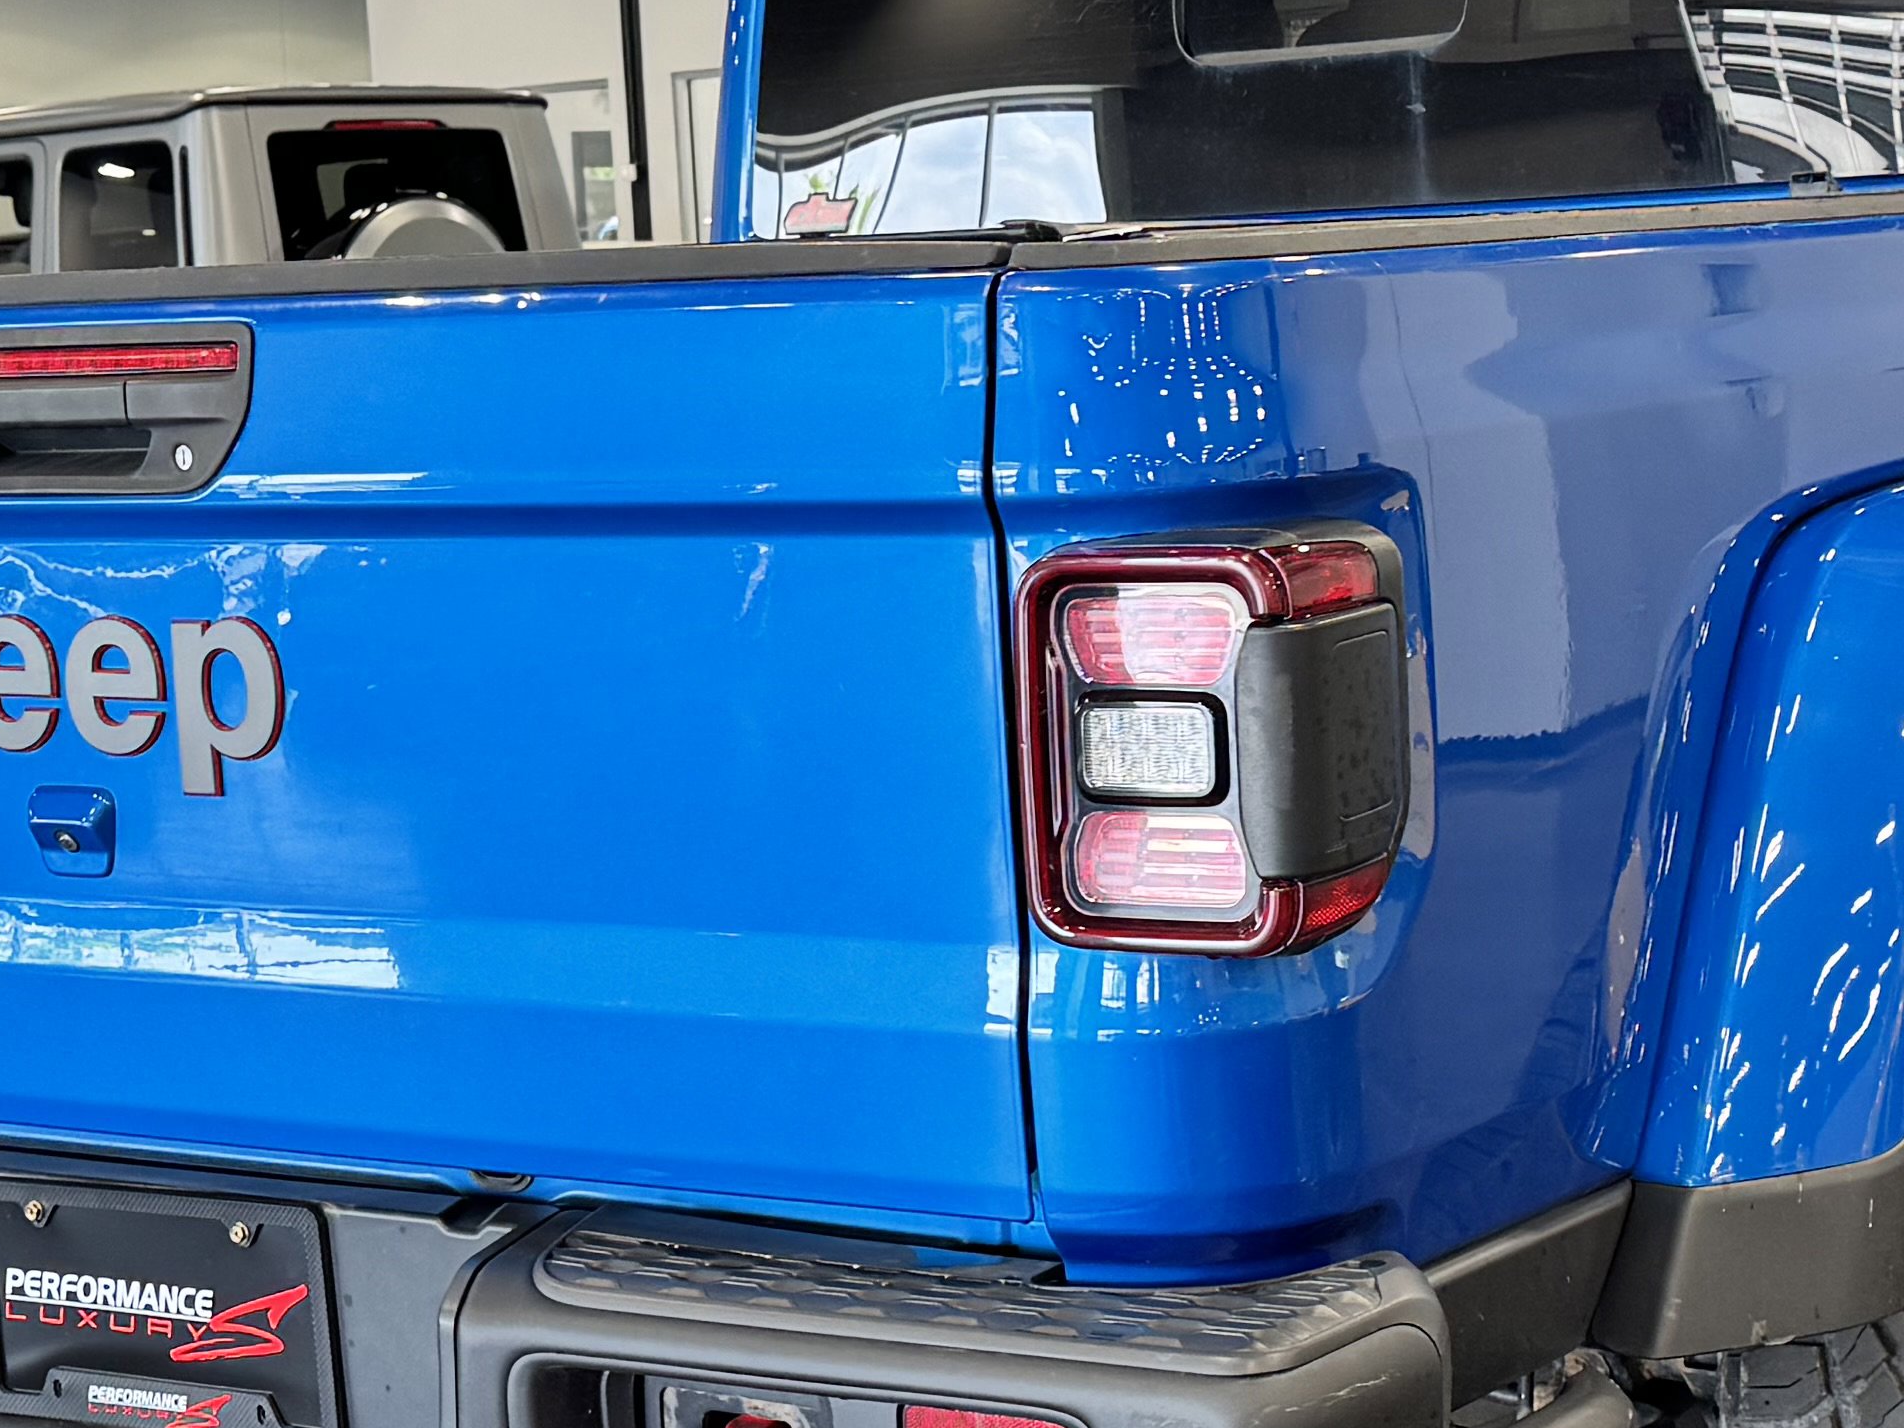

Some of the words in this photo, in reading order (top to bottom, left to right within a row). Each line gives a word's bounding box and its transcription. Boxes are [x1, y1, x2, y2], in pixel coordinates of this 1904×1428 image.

[5, 1267, 214, 1318] PERFORMANCE
[4, 1301, 208, 1341] LUXURY
[87, 1384, 188, 1411] PERFORMANCE
